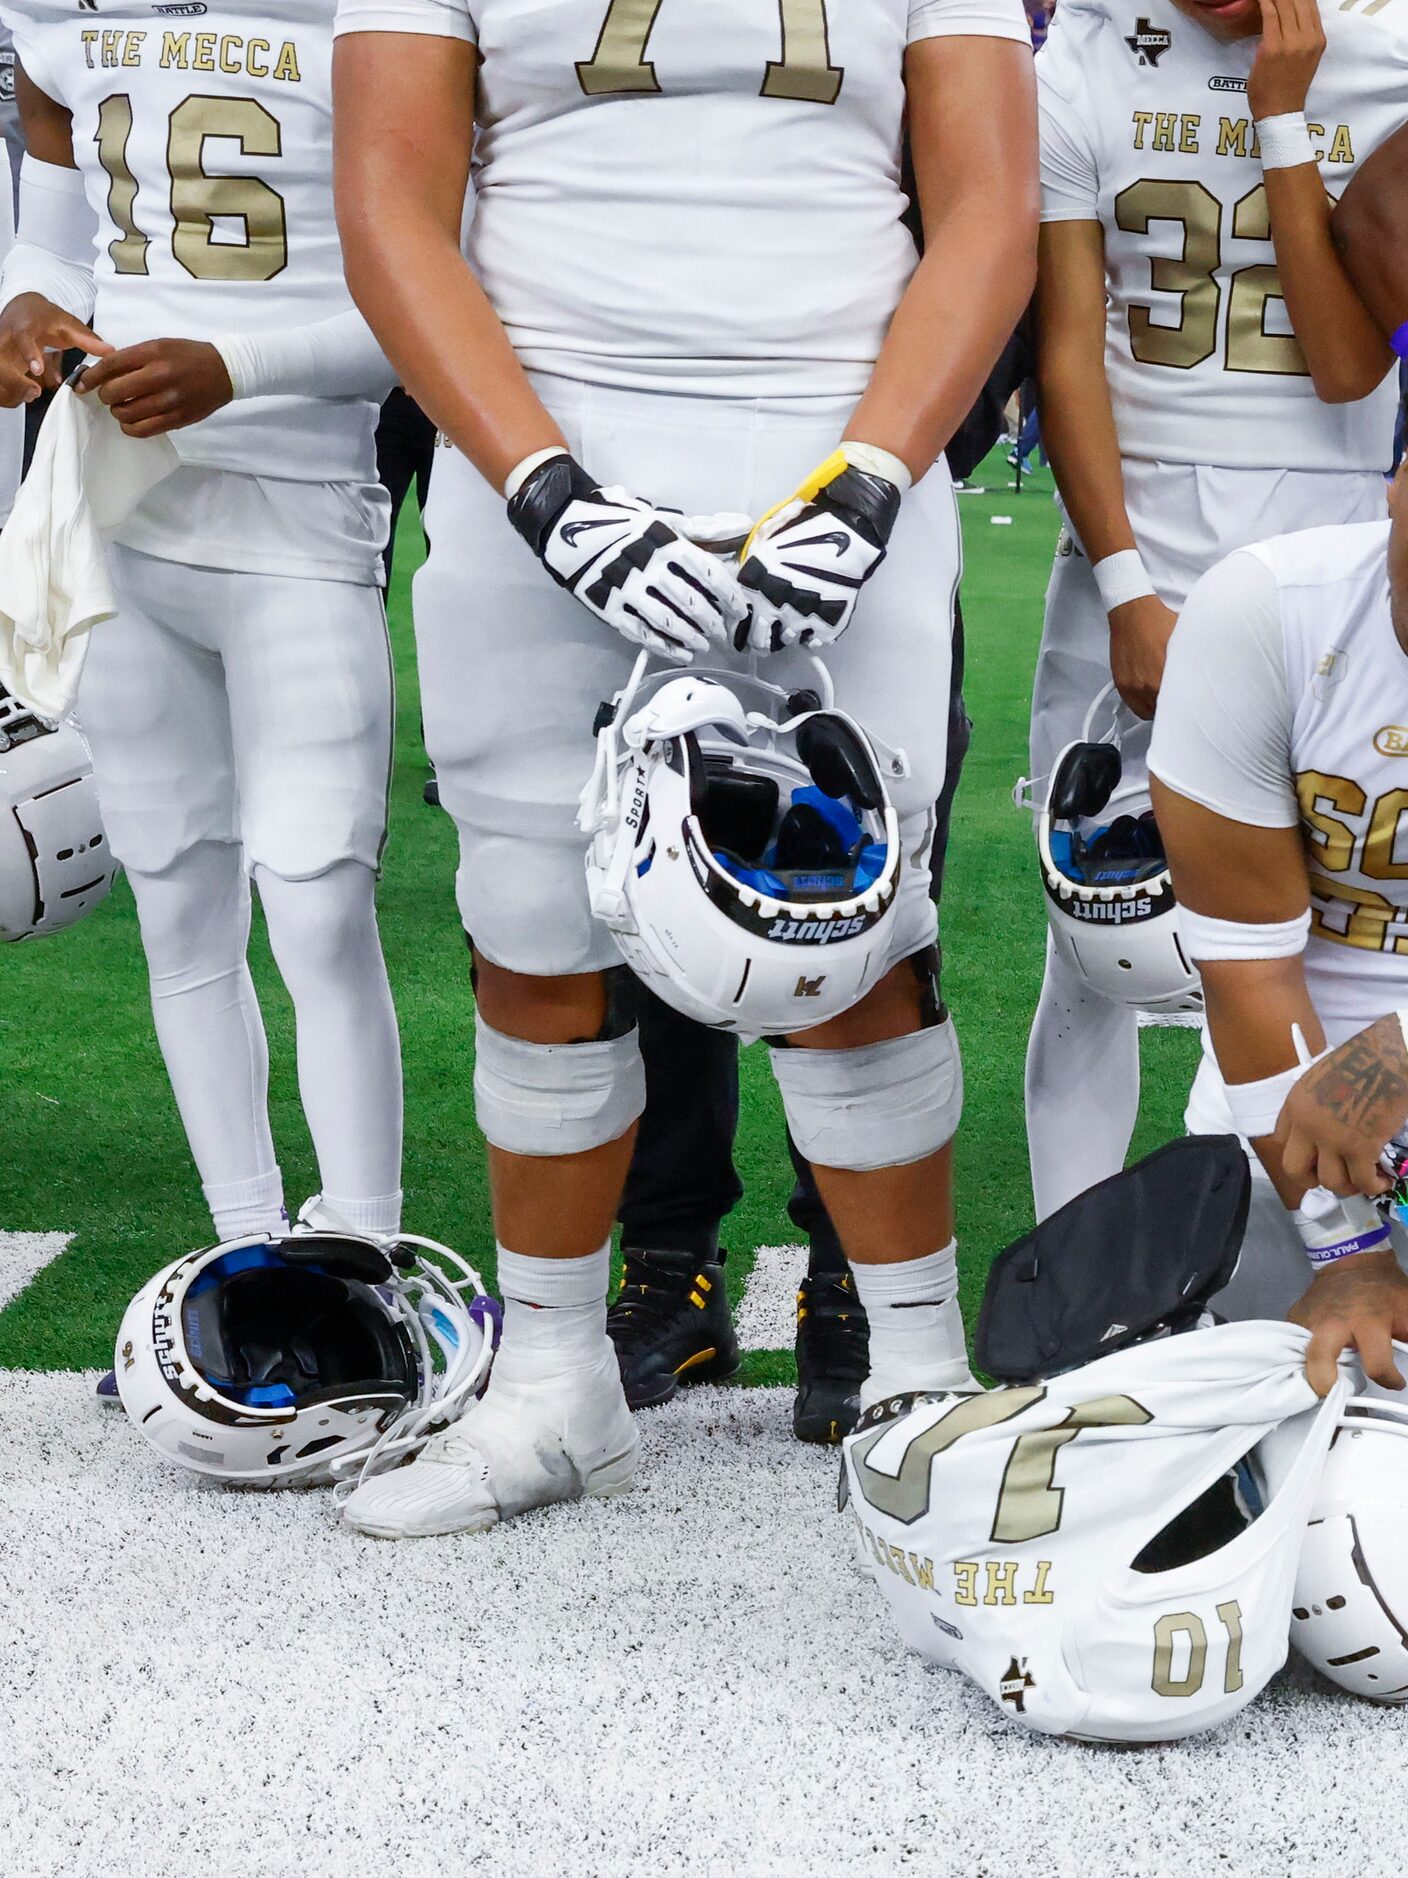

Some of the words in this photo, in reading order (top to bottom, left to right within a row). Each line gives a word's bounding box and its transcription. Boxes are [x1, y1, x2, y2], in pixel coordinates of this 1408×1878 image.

[81, 30, 147, 68] THE
[160, 32, 301, 82] MECCA
[1136, 34, 1170, 46] MECCA
[1212, 78, 1248, 91] BATT
[1132, 111, 1201, 153] THE
[1216, 117, 1354, 164] MCA
[93, 93, 289, 282] 16
[768, 915, 866, 944] schutt
[1072, 899, 1152, 924] schutt
[954, 1561, 1054, 1606] THE
[1151, 1599, 1244, 1698] 10
